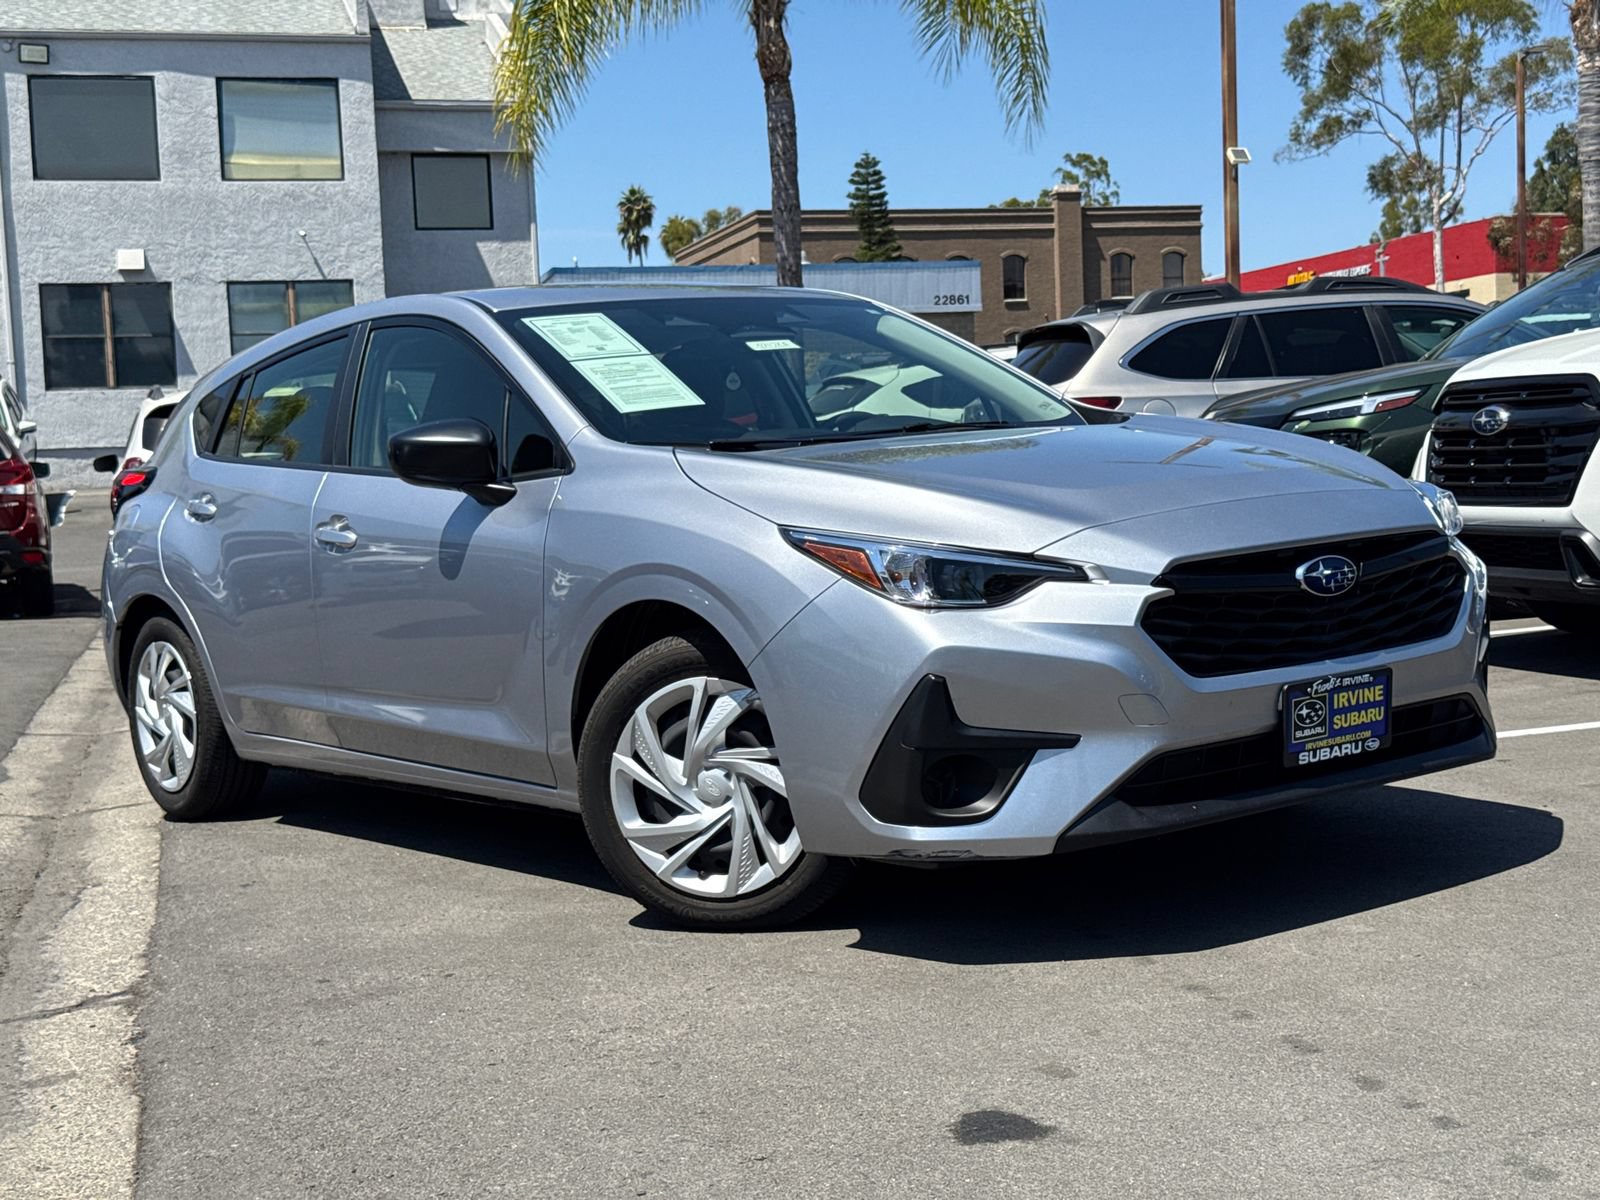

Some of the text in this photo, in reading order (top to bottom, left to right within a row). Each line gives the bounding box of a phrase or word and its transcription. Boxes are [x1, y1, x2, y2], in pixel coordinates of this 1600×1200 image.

[933, 294, 970, 306] 22861
[1342, 674, 1370, 687] IRVINE
[1333, 685, 1384, 709] IRVINE
[1333, 706, 1384, 730] SUBARU
[1295, 725, 1325, 738] SUBARU
[1305, 730, 1372, 750] IRVINESUBARU.COM
[1298, 741, 1362, 765] SUBARU
